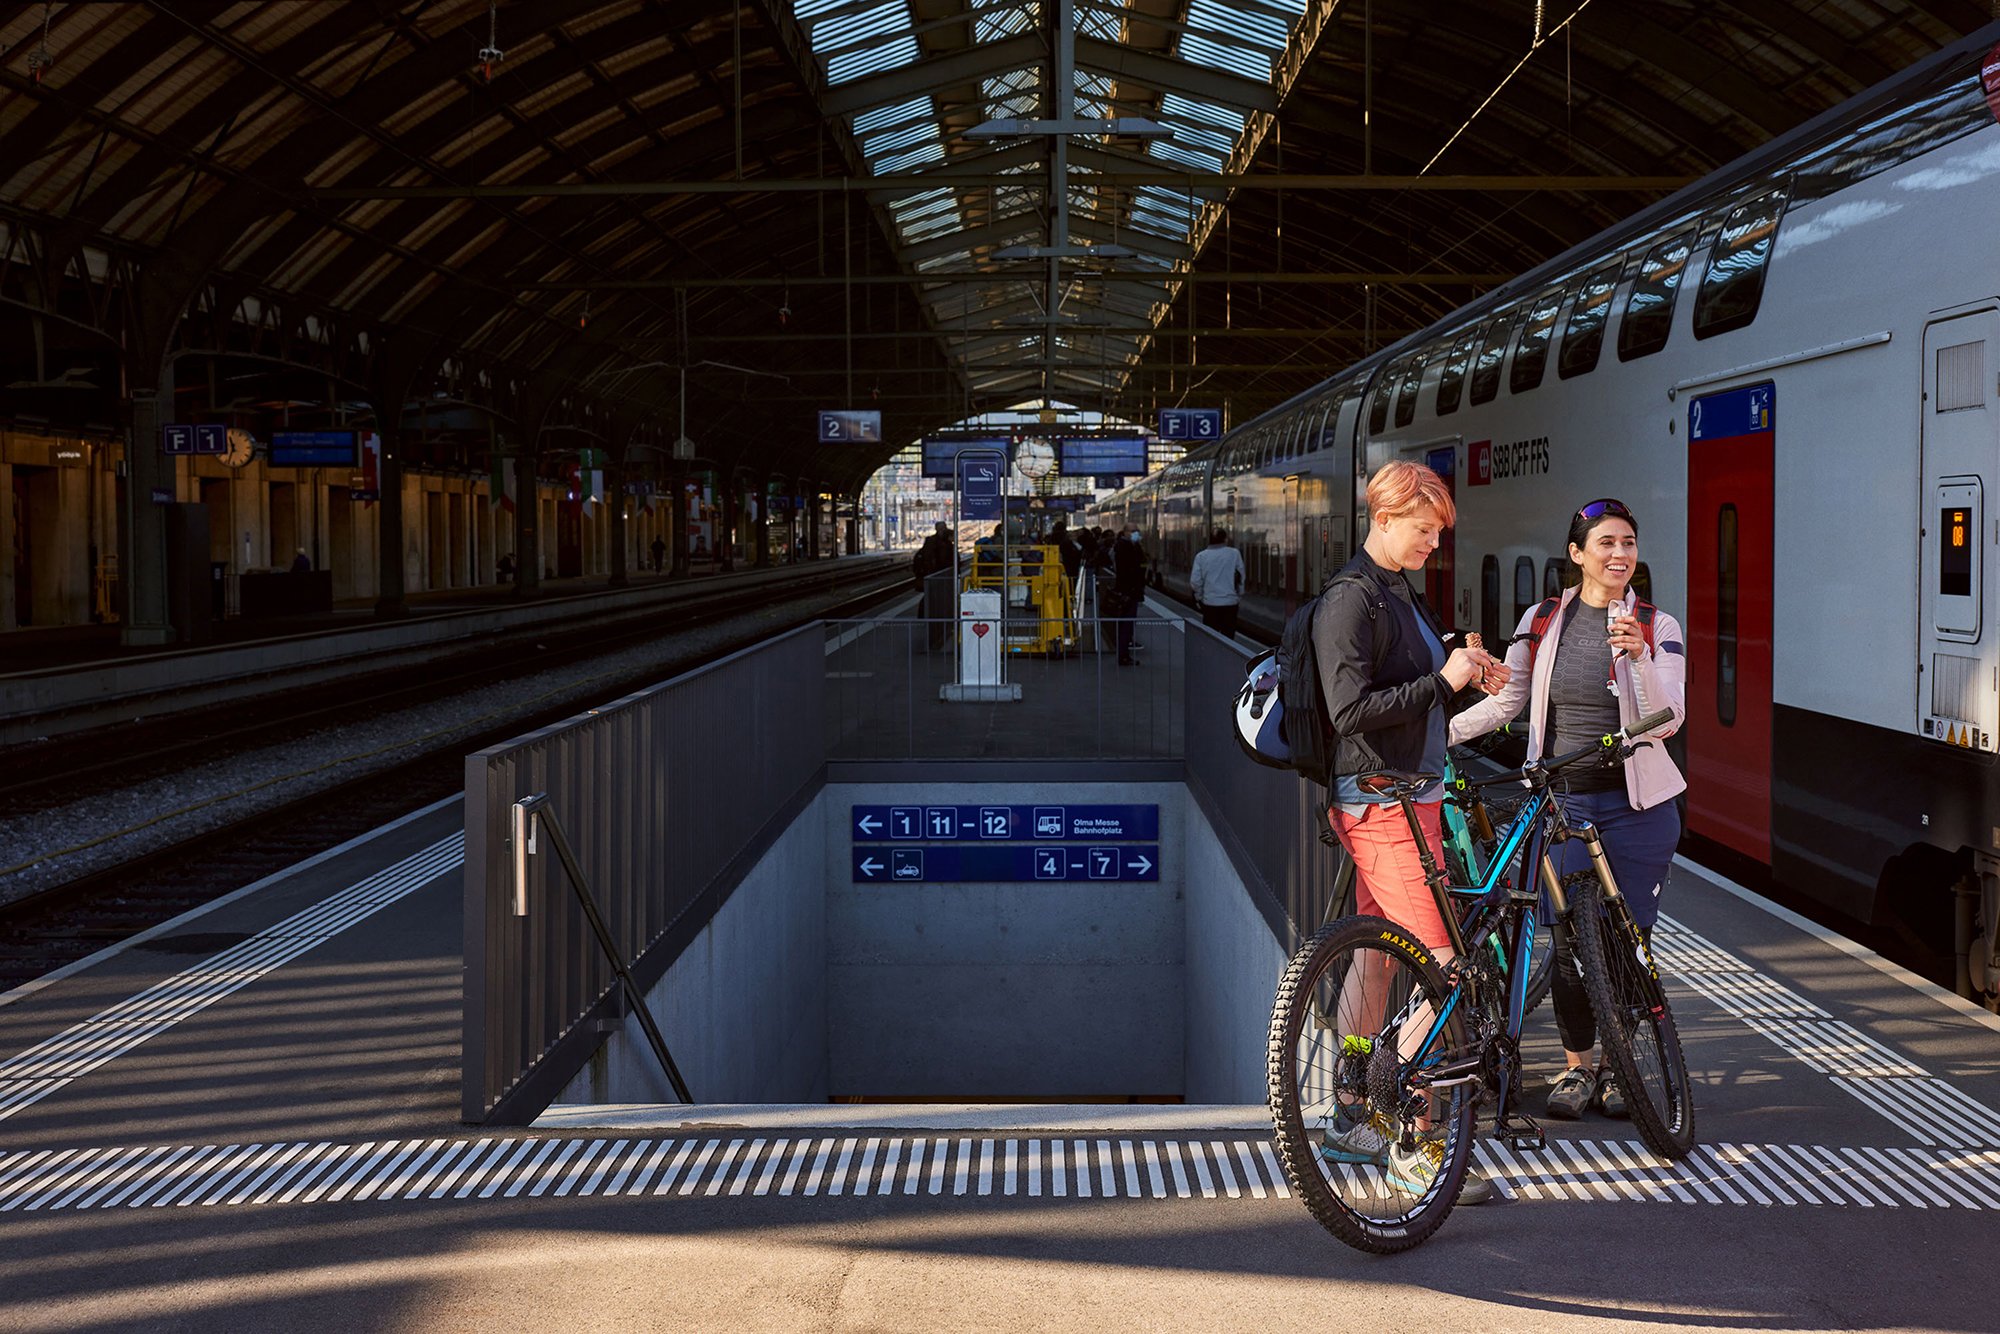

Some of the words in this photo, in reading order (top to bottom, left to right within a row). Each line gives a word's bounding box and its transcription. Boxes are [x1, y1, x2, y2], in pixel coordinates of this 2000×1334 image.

[1168, 418, 1181, 435] F
[1199, 418, 1211, 435] 3
[1693, 400, 1702, 439] 2
[828, 421, 840, 437] 2
[860, 421, 871, 437] F
[172, 433, 185, 450] F
[205, 433, 215, 449] 1
[1493, 444, 1510, 479] SBB
[1511, 440, 1529, 477] CFF
[1530, 436, 1549, 474] FFS
[901, 816, 910, 835] 1
[932, 816, 950, 835] 11
[983, 816, 1007, 835] 12
[1073, 818, 1094, 826] Olma
[1073, 827, 1123, 835] Bahnhofplatz
[1043, 857, 1057, 875] 4
[1097, 857, 1111, 875] 7
[1380, 931, 1428, 965] MAXXIS
